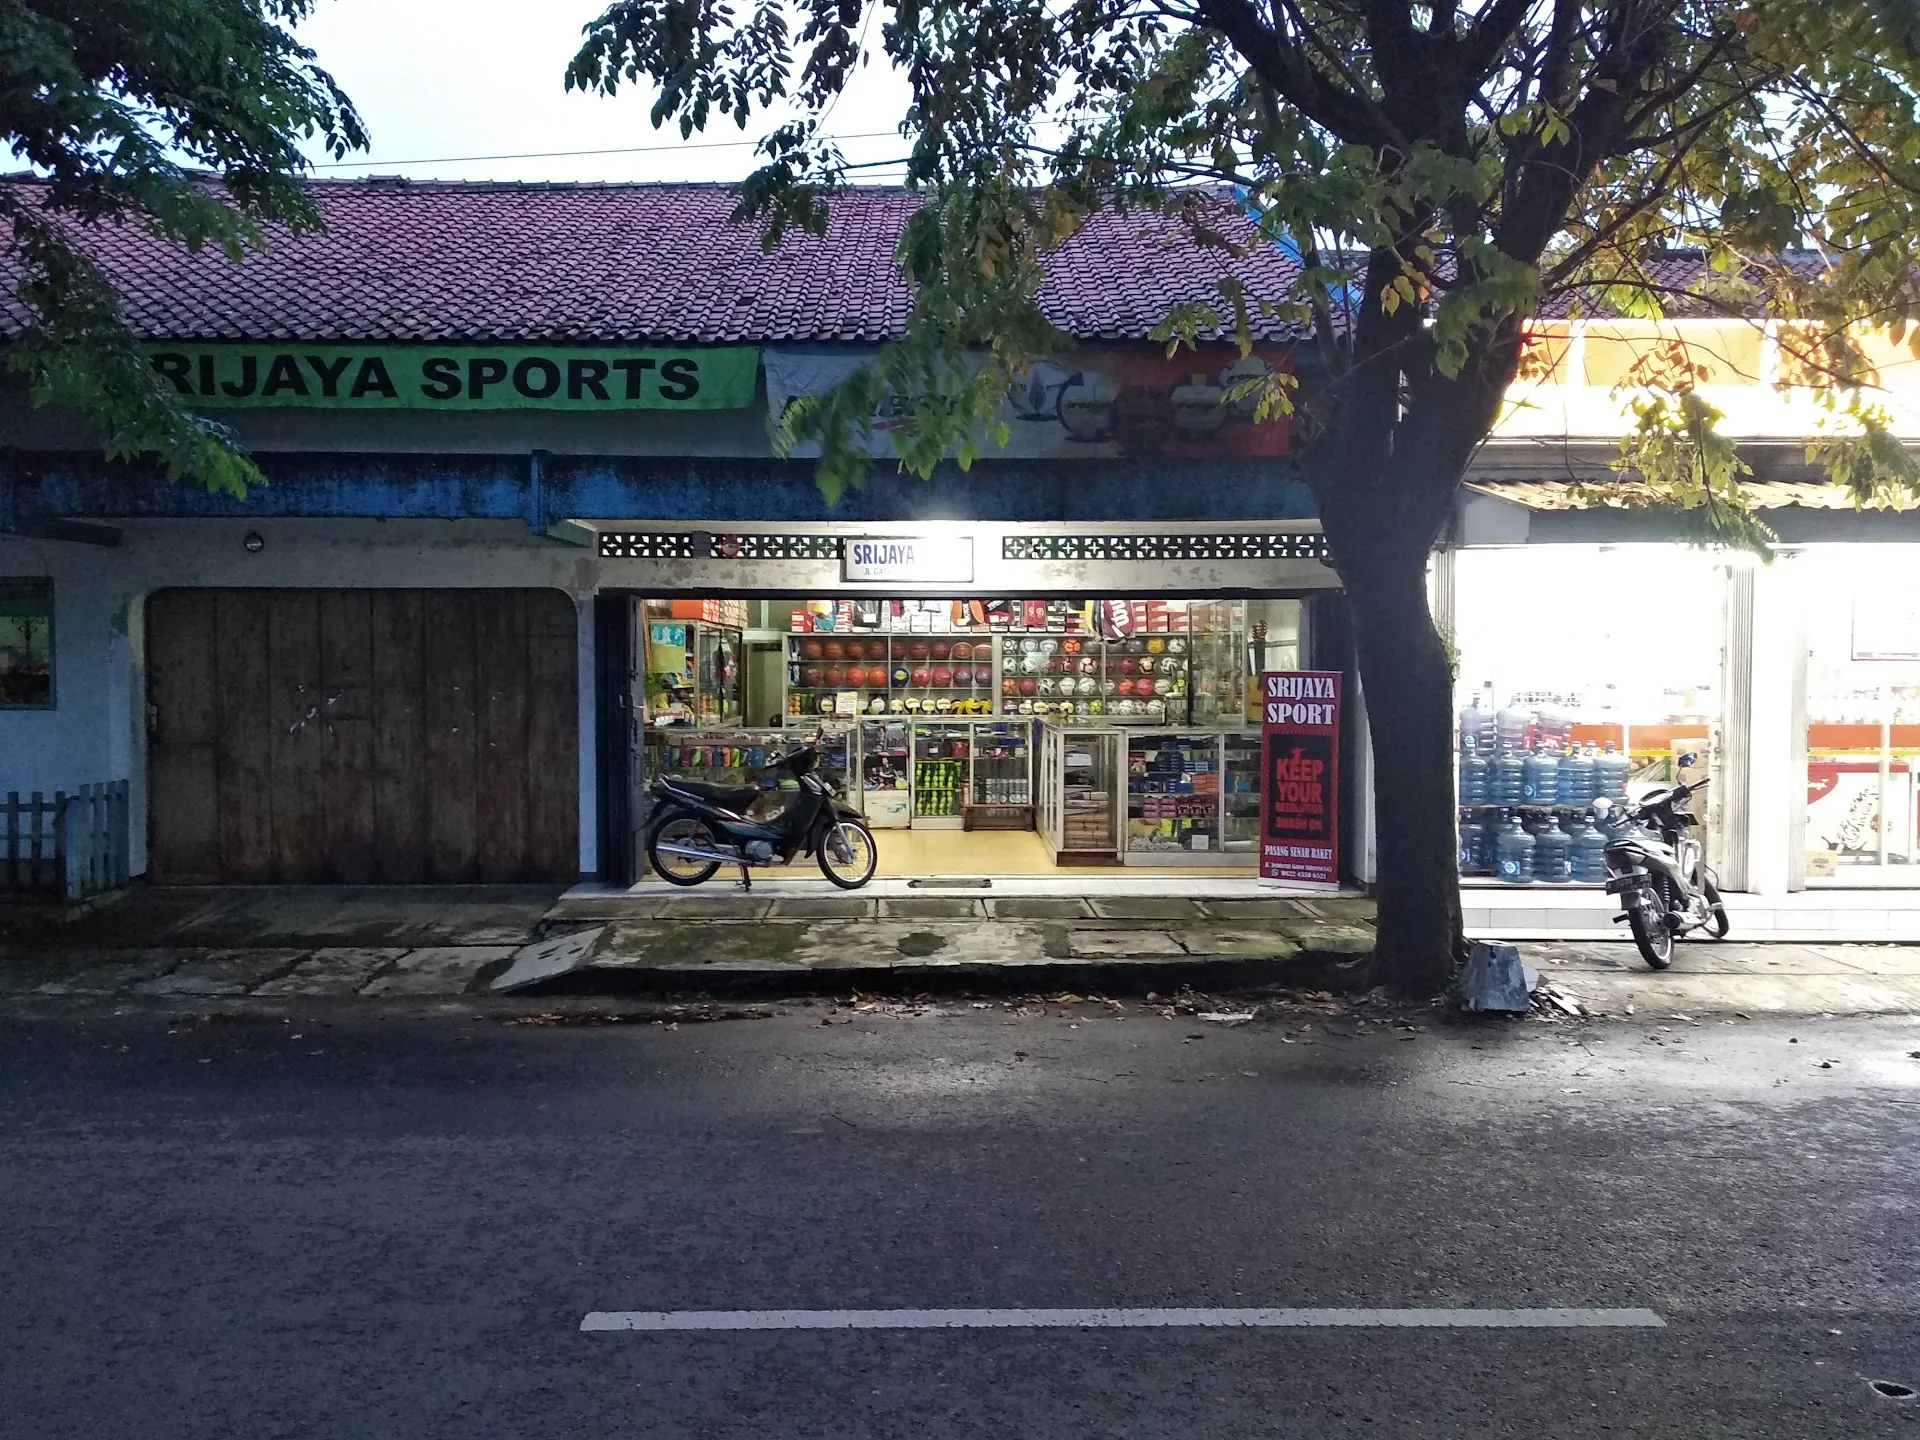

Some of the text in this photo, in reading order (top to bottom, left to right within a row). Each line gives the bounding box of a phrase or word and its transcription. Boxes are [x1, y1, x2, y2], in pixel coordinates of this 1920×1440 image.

[149, 352, 700, 401] RIJAYA SPORTS
[853, 544, 914, 565] SRIJAYA
[1268, 677, 1335, 700] SRIJAYA
[1267, 702, 1336, 725] SPORT
[1276, 758, 1324, 781] KEEP
[1277, 782, 1323, 803] YOUR
[1264, 844, 1332, 860] PASANG SENAR RAKET
